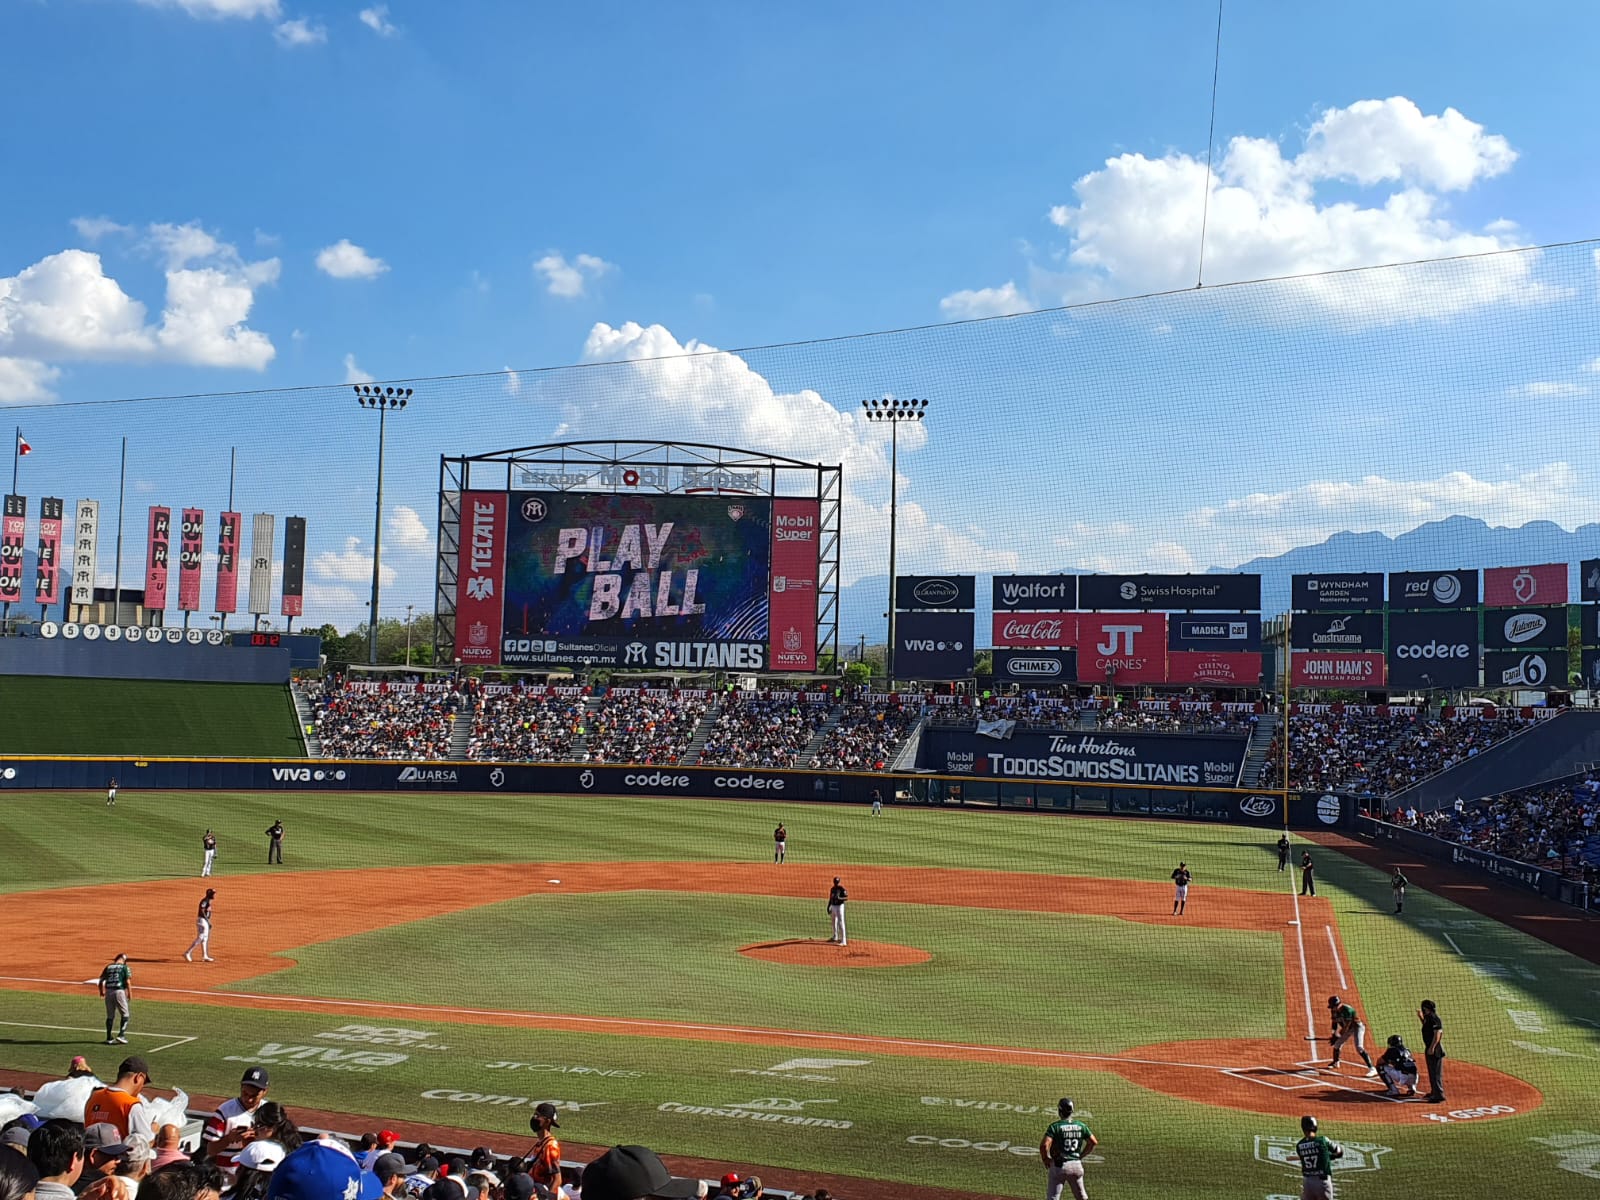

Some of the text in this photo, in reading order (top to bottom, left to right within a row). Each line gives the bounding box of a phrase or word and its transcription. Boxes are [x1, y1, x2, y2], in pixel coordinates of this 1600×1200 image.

[601, 466, 668, 487] Mobil
[682, 467, 757, 493] Super
[776, 516, 813, 527] Mobil
[471, 499, 494, 573] TECATE
[775, 528, 813, 540] Super
[553, 522, 675, 574] PLAY
[1002, 582, 1066, 598] Walfort
[1320, 581, 1369, 589] WYNDHAM
[1405, 579, 1430, 593] red
[588, 569, 706, 621] BALL
[1140, 585, 1216, 598] Swiss Hospital
[46, 626, 52, 635] 1
[68, 626, 74, 635] 5
[89, 627, 95, 636] 7
[110, 628, 116, 637] 9
[127, 628, 139, 638] 13
[148, 629, 160, 639] 17
[168, 630, 180, 640] 20
[1003, 619, 1064, 640] Coca-Cola
[1191, 626, 1246, 635] MADISA CAT
[189, 631, 200, 641] 21
[209, 632, 221, 641] 22
[1097, 625, 1143, 656] JT
[1312, 632, 1362, 644] Construrama
[557, 642, 618, 652] SultanesOficial
[904, 639, 935, 651] viva
[1396, 639, 1470, 659] codere
[503, 654, 617, 664] www.sultanes.com.mx
[655, 641, 763, 669] SULTANES
[1011, 660, 1056, 672] CHIMEX
[1095, 659, 1142, 670] CARNES
[1198, 662, 1230, 670] CHINO
[1303, 660, 1373, 675] JOHN HAM'S
[1503, 654, 1542, 684] Canal 6
[1192, 669, 1236, 679] ARRIETA
[422, 683, 447, 694] TECAT
[611, 687, 640, 697] TECAE
[645, 688, 669, 698] TECAT
[735, 691, 764, 700] TECAE
[934, 695, 963, 705] TECAE
[1137, 700, 1171, 710] TECATE
[1180, 701, 1213, 711] TECATE
[1221, 702, 1256, 713] TECATE
[1297, 703, 1332, 715] TECATE
[1049, 735, 1137, 757] Tim Hortons
[947, 752, 974, 762] Mobil
[947, 761, 974, 772] Super
[1204, 761, 1235, 772] Mobil
[272, 768, 311, 782] viva
[624, 771, 690, 787] codere
[1204, 771, 1235, 782] Super
[714, 775, 785, 790] codere
[1242, 796, 1274, 815] Lety
[1317, 808, 1340, 816] IMPAC
[257, 1043, 409, 1066] viva
[485, 1061, 642, 1078] JT CARNES
[420, 1089, 610, 1112] Comex
[657, 1102, 854, 1129] Construrama
[1448, 1104, 1516, 1119] G500
[906, 1134, 1106, 1164] codee
[1063, 1138, 1079, 1151] 93
[1303, 1155, 1318, 1169] 57
